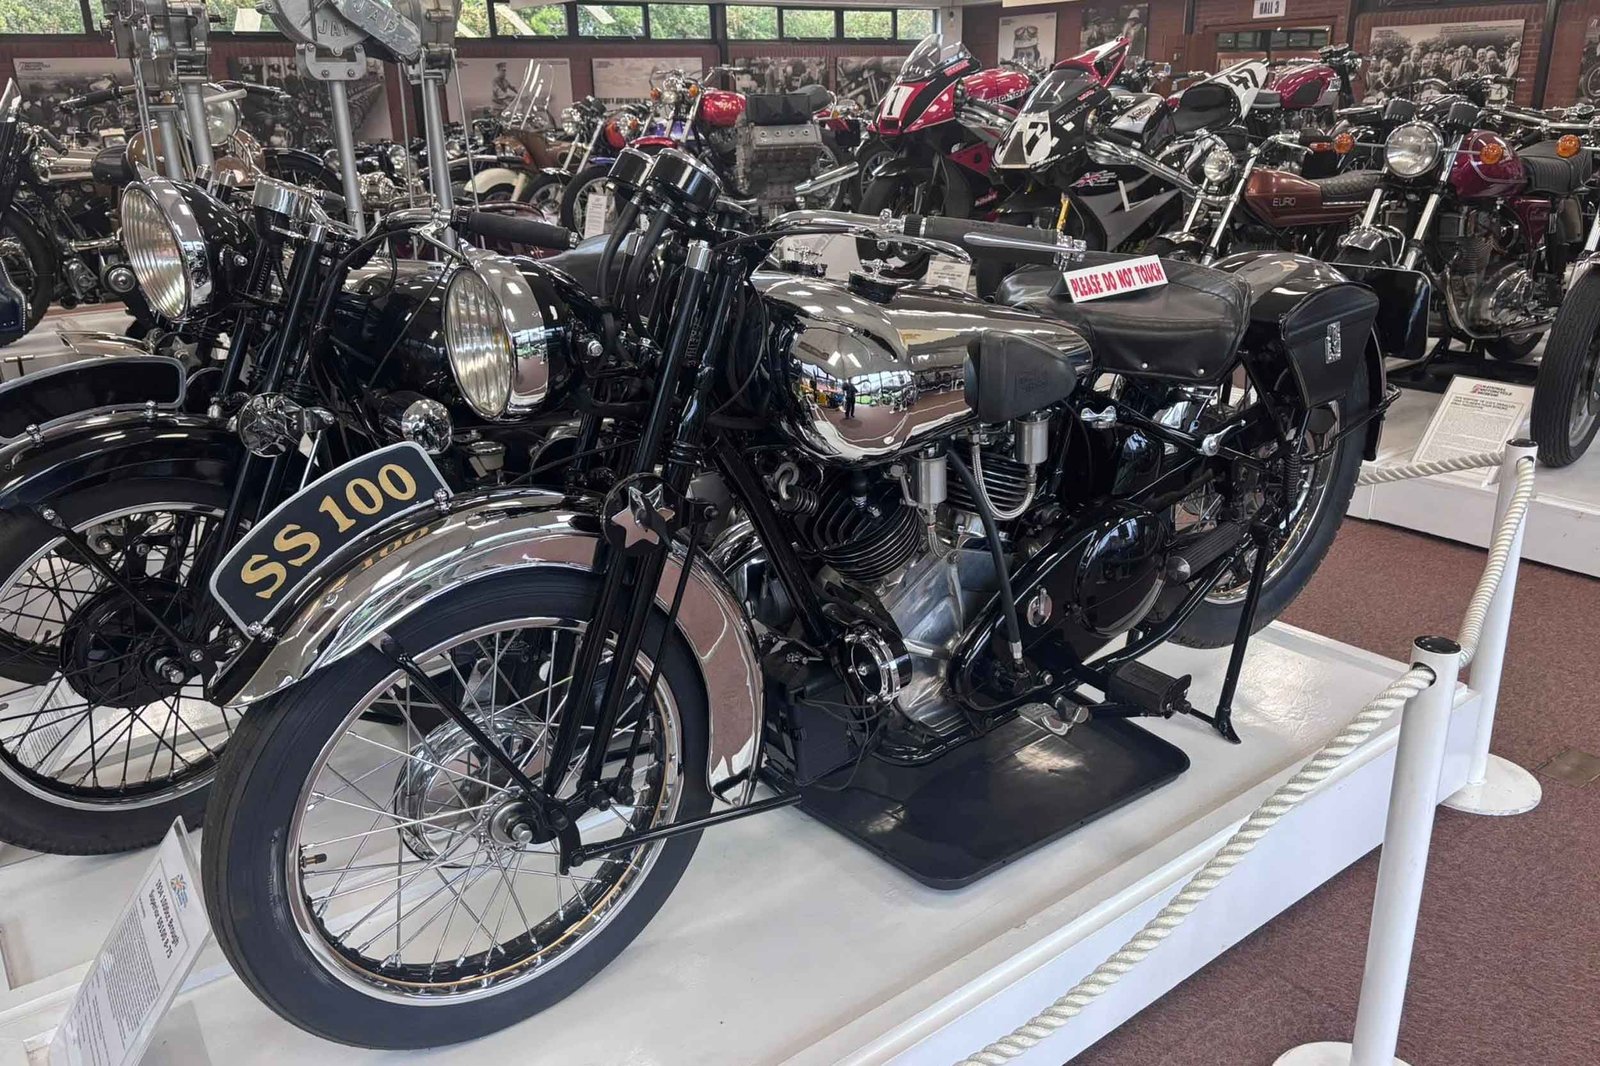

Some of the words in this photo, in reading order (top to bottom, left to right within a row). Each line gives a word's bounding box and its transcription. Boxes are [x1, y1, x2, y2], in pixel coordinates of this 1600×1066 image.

[1260, 2, 1274, 15] HALL
[1274, 0, 1280, 14] 3
[1225, 68, 1260, 90] 47
[1272, 196, 1296, 207] EURO
[1070, 273, 1103, 297] PLEASE
[1102, 271, 1117, 291] DO
[1116, 267, 1137, 289] NOT
[1134, 262, 1165, 285] TOUCH
[240, 523, 321, 599] SS
[318, 463, 417, 533] 100
